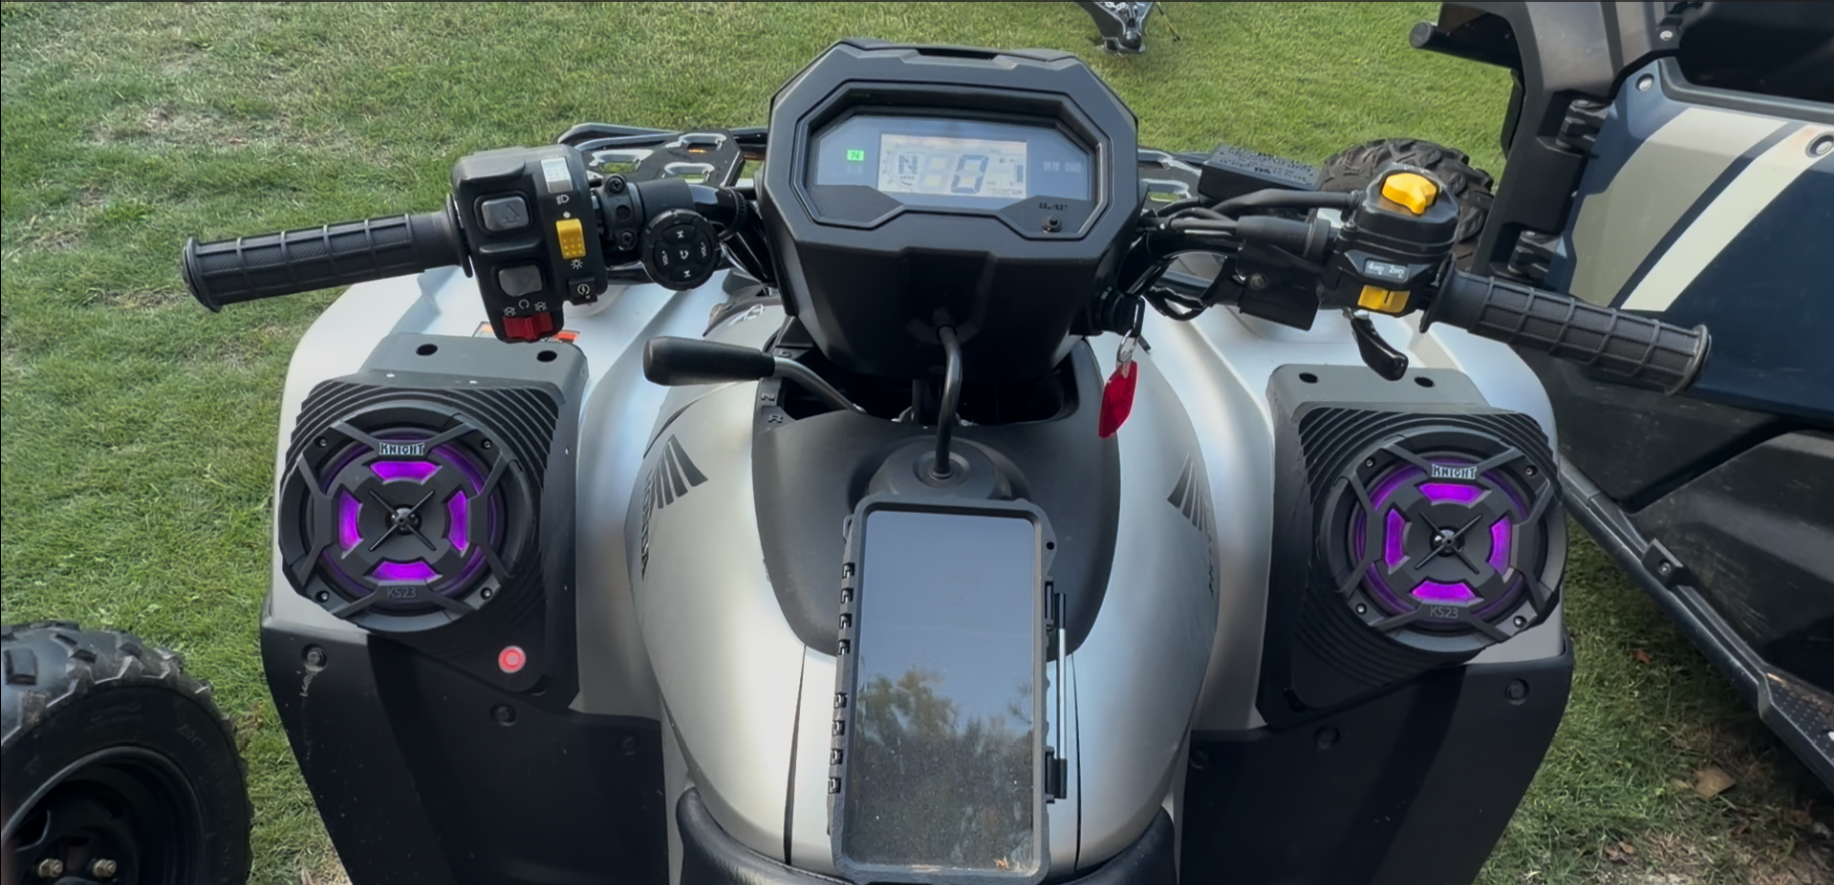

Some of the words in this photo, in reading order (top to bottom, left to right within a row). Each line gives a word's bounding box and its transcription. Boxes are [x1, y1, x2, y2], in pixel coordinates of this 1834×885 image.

[899, 155, 918, 175] N
[951, 154, 989, 194] 0
[379, 441, 425, 456] KNIGHT
[1431, 463, 1477, 479] KNIGHT
[386, 586, 417, 599] KS23
[1430, 605, 1459, 619] KS23
